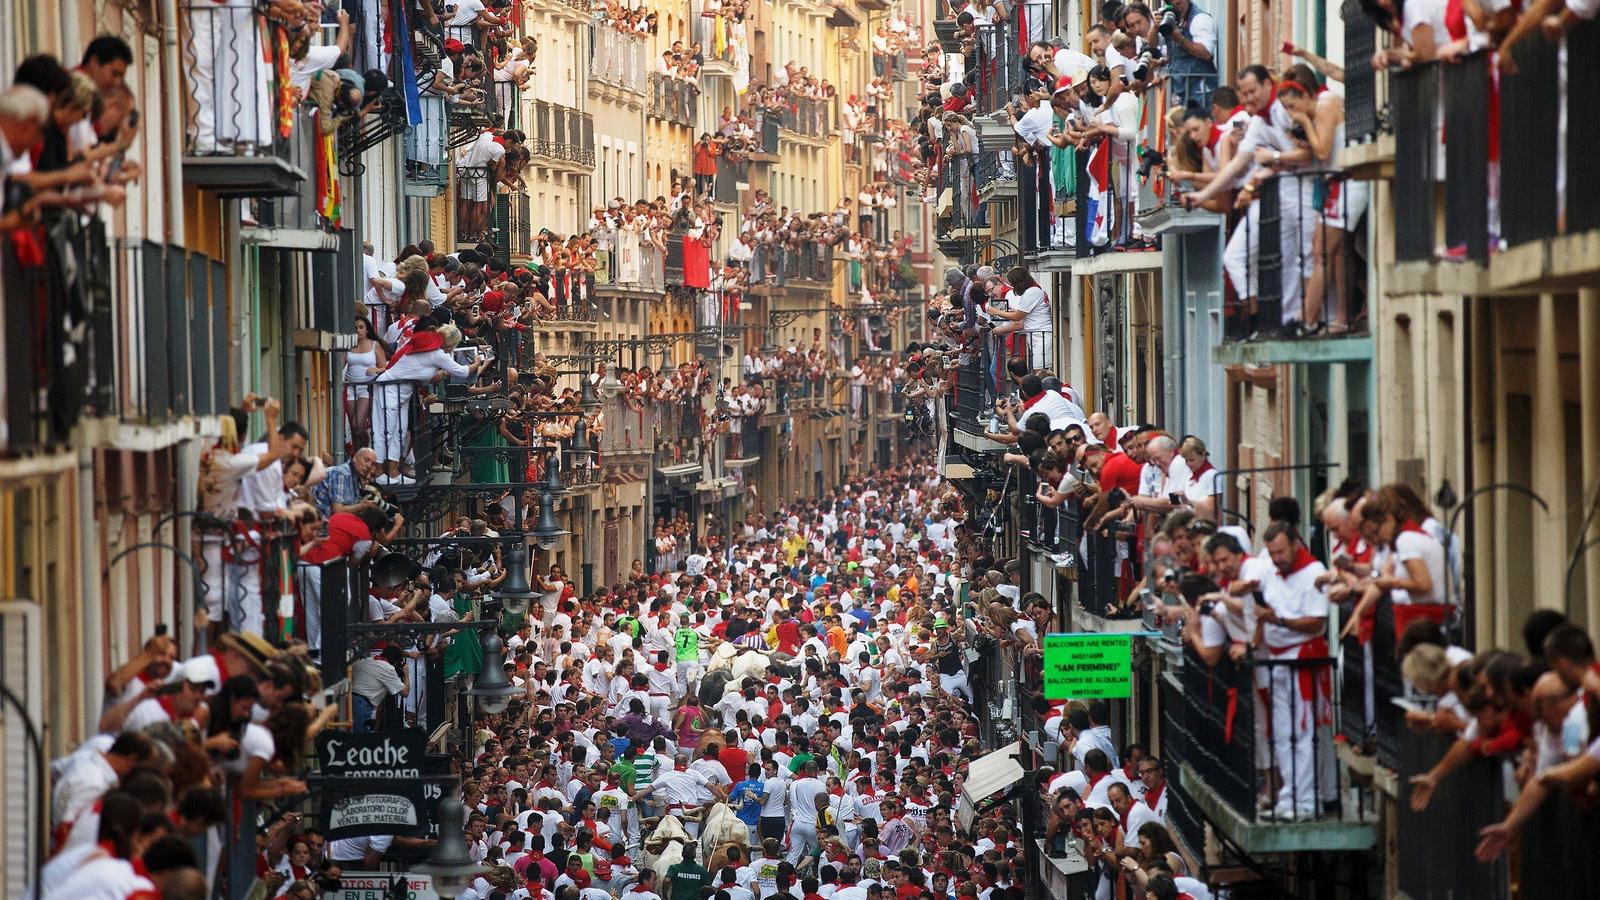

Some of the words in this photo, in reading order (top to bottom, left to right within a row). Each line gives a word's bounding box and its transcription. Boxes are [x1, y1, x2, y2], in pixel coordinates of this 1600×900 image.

[682, 634, 689, 648] 7
[327, 738, 409, 767] Leache
[341, 804, 385, 817] LABORATORIO
[386, 805, 409, 815] COLOR
[337, 815, 359, 825] VENTA
[362, 814, 371, 823] DE
[374, 814, 409, 824] MATERIAL
[340, 880, 374, 890] OTOS
[344, 891, 360, 900] EN
[365, 891, 379, 900] EL
